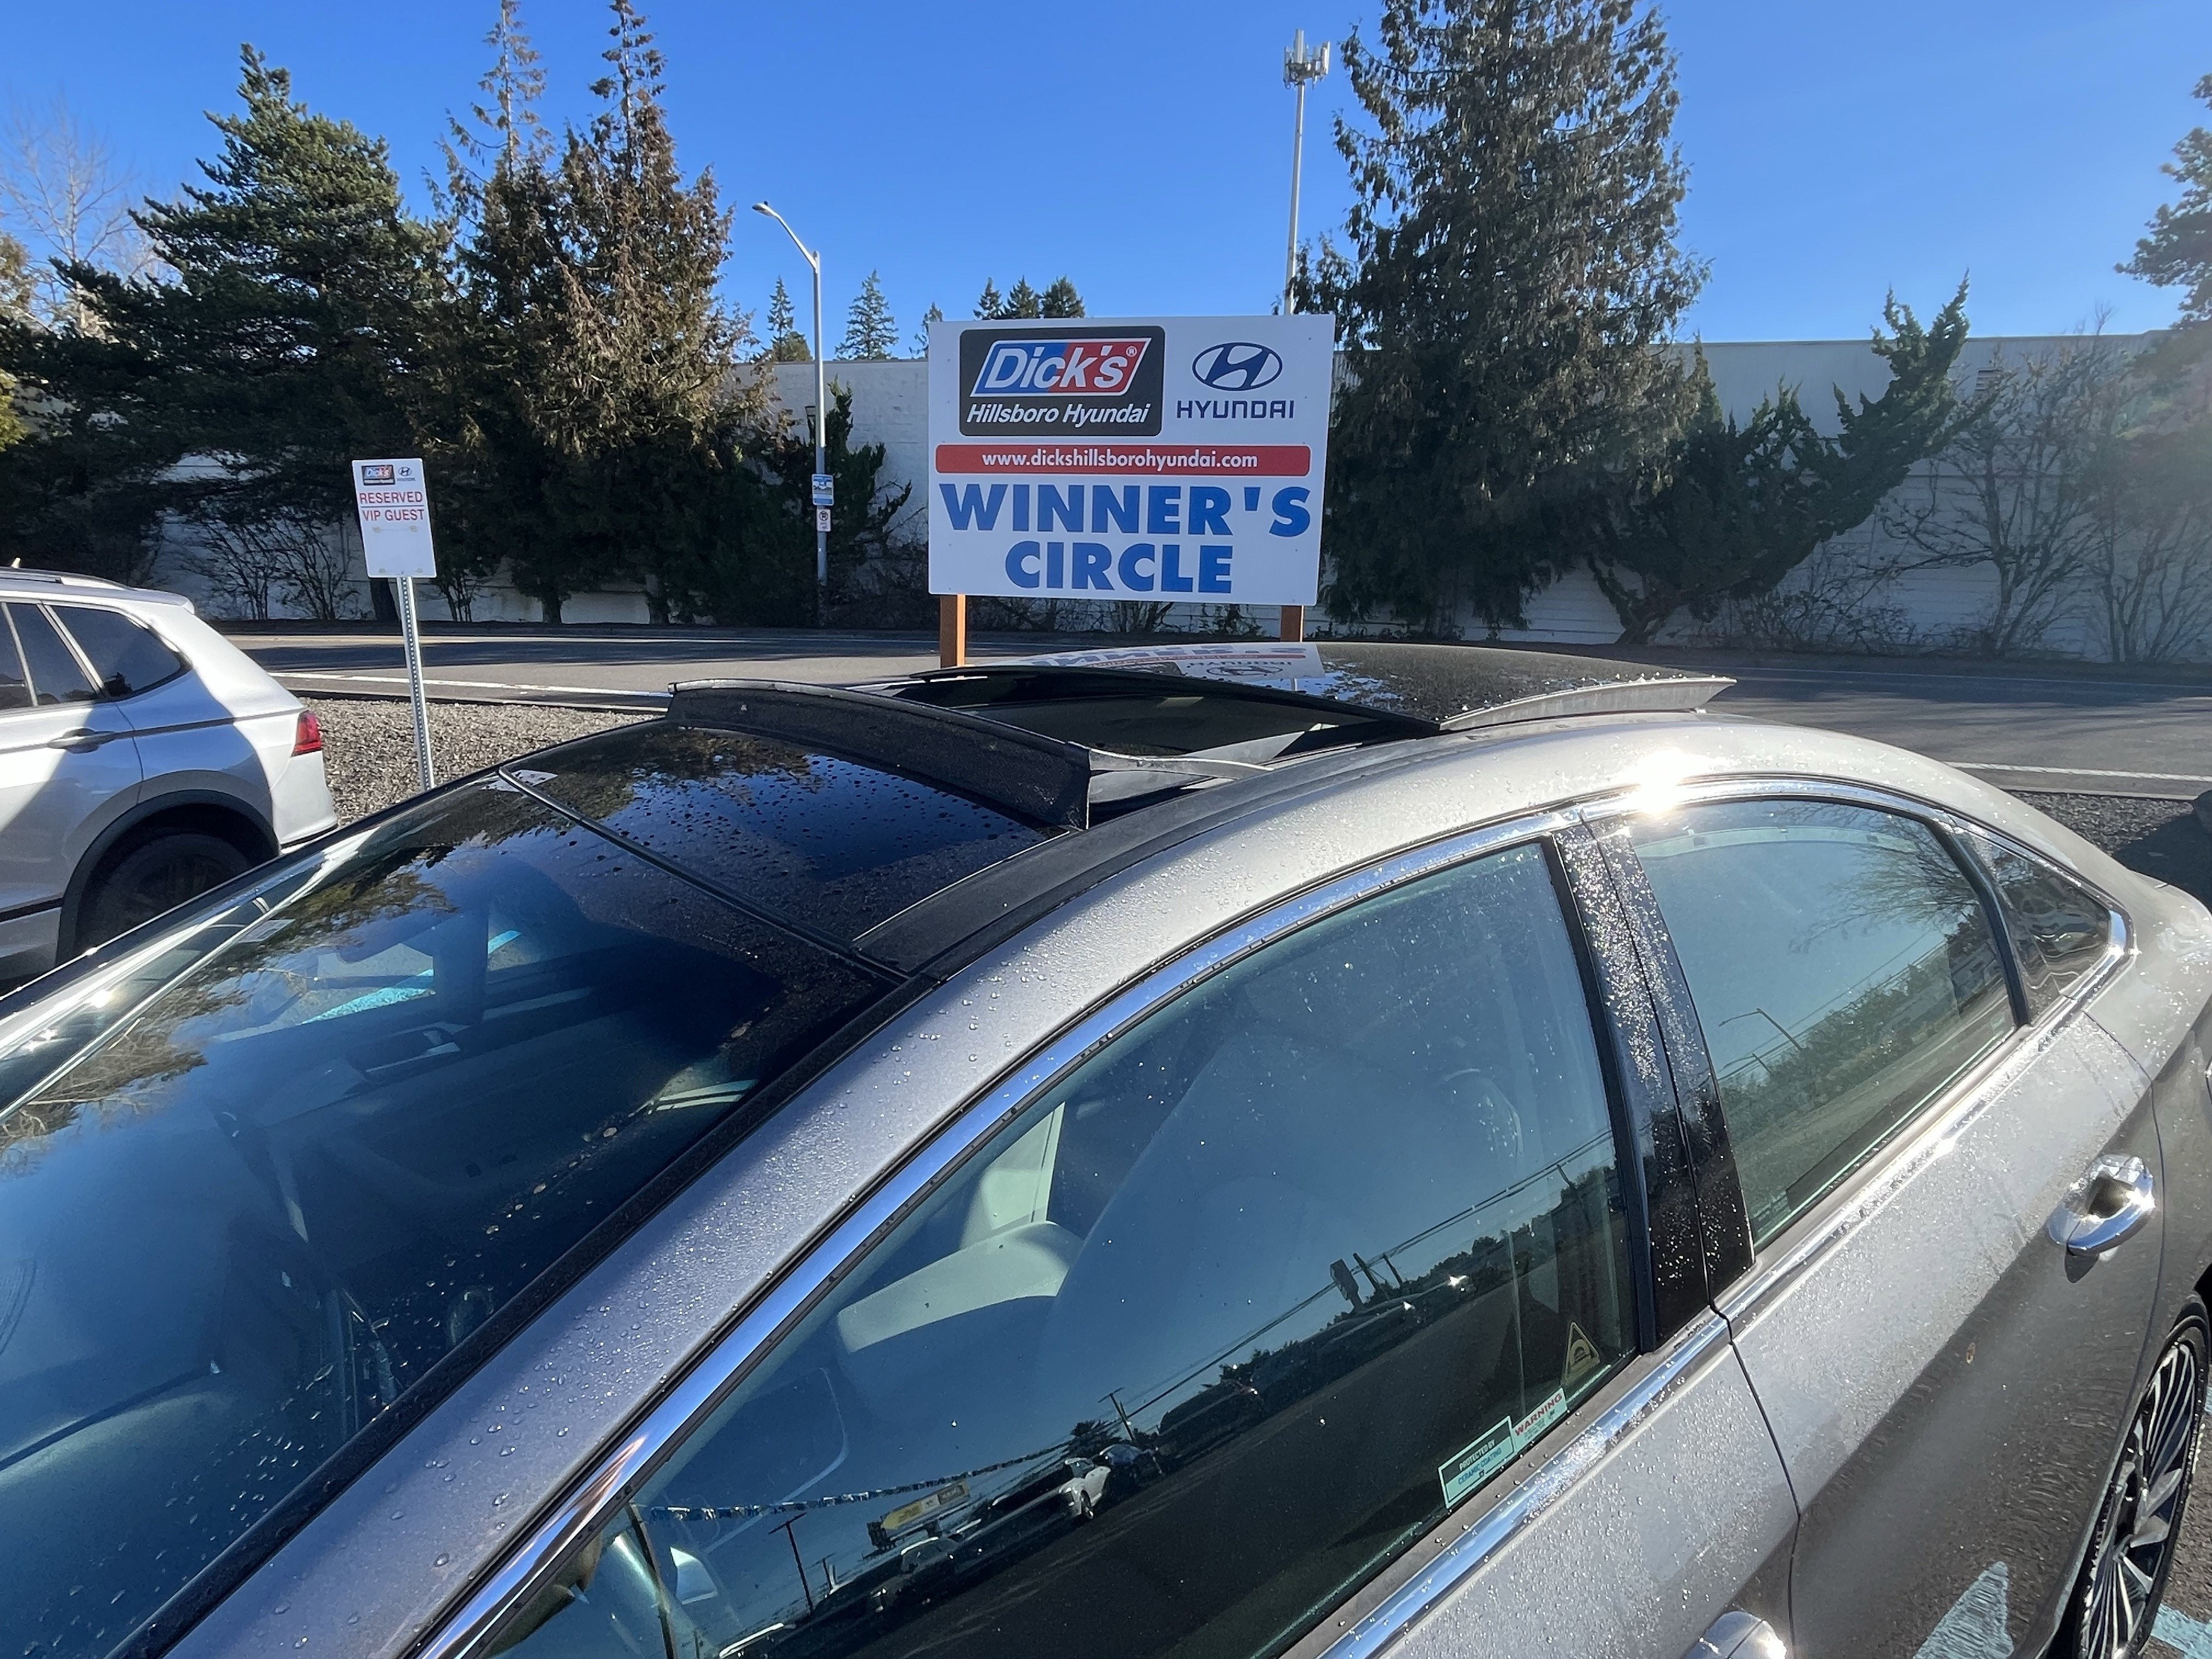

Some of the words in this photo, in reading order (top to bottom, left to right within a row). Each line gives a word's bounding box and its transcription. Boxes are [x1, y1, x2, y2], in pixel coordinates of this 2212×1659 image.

[966, 404, 1060, 423] Hillsboro
[1062, 404, 1151, 427] Hyundai
[1176, 400, 1294, 419] HYUNDAI
[982, 449, 1258, 469] www.dickshillsborohyundai.com
[359, 491, 422, 504] RESERVED
[362, 510, 381, 521] VIP
[385, 509, 425, 521] GUEST
[939, 483, 1311, 538] WINNER'S
[1005, 540, 1234, 594] CIRCLE
[1515, 1393, 1562, 1436] WARNING
